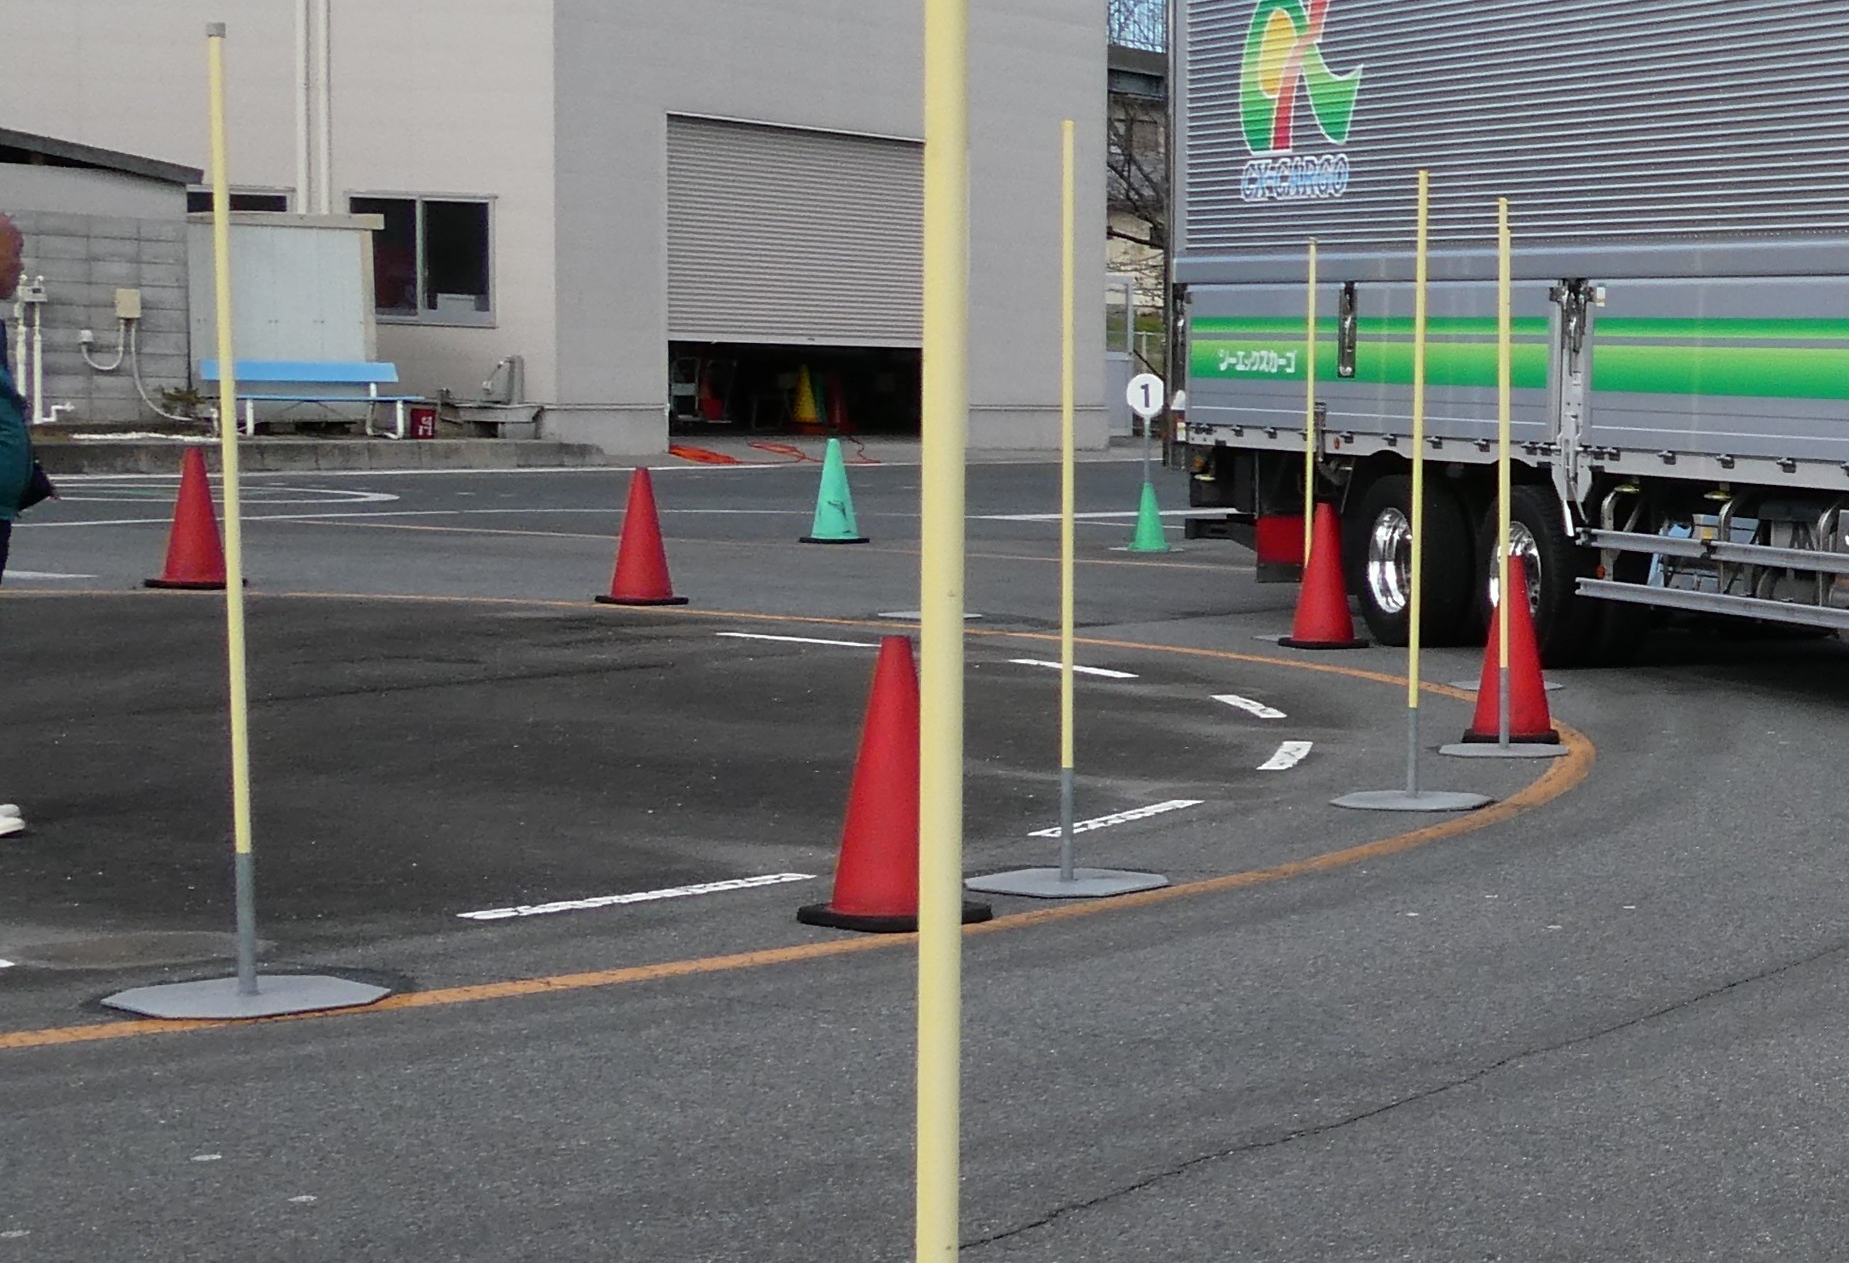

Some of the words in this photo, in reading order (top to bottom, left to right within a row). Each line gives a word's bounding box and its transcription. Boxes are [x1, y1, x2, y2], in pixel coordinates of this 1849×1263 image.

[1242, 154, 1349, 201] CX-CARGO
[1218, 349, 1298, 373] シーエックスカーゴ
[1140, 383, 1150, 408] 1
